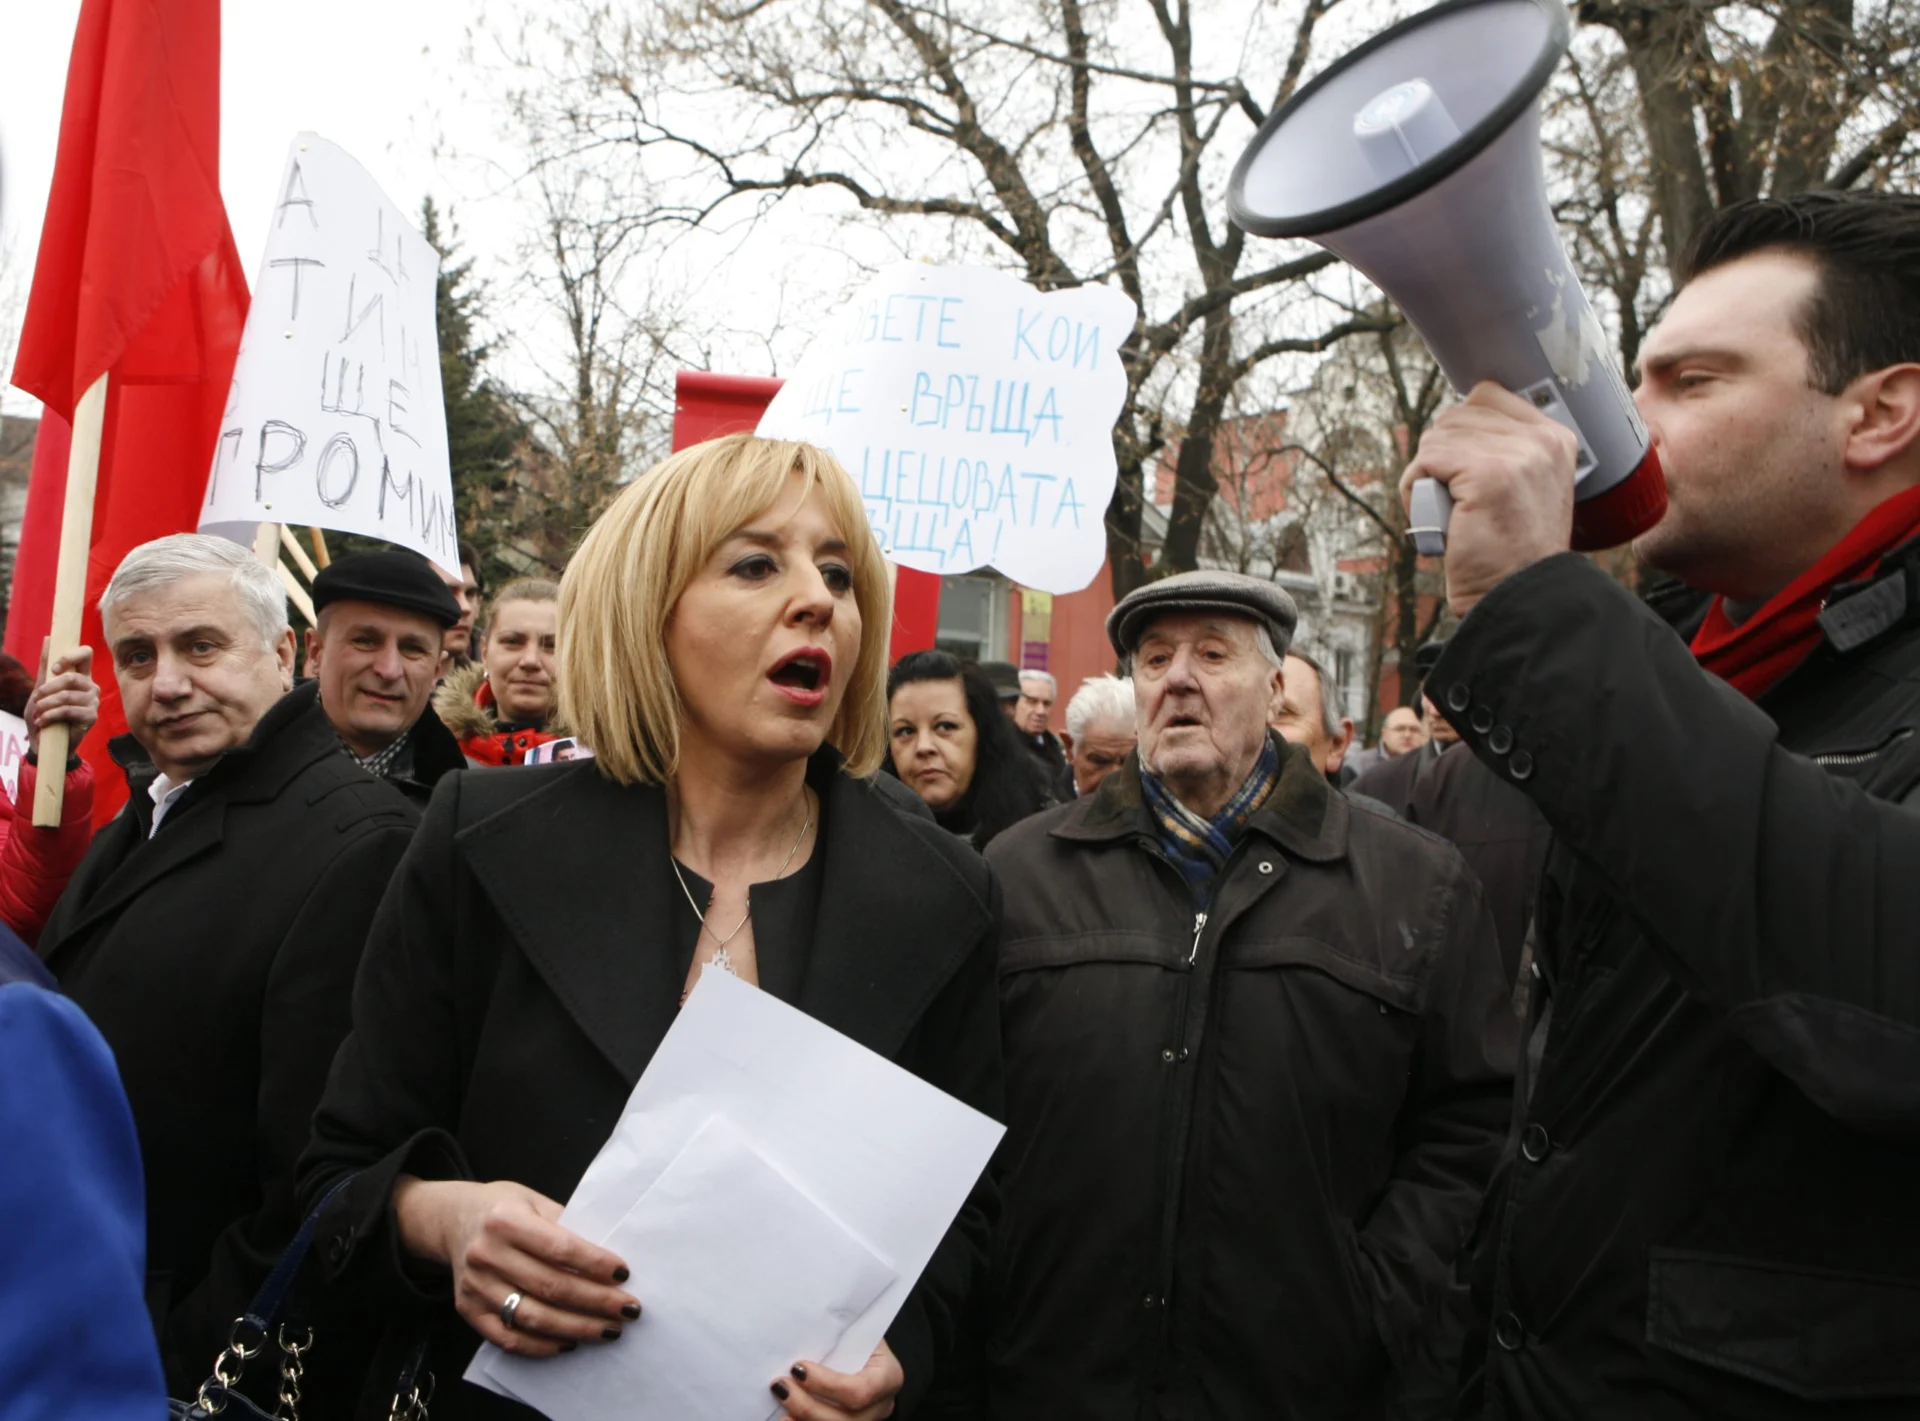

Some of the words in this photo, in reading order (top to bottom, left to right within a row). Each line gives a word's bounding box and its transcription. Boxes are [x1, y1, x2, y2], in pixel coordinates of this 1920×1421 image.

[909, 370, 1064, 448] ВРЪЩА
[861, 445, 1086, 530] ЦЕЦОВАТА
[865, 507, 1004, 569] ЪЩА!
